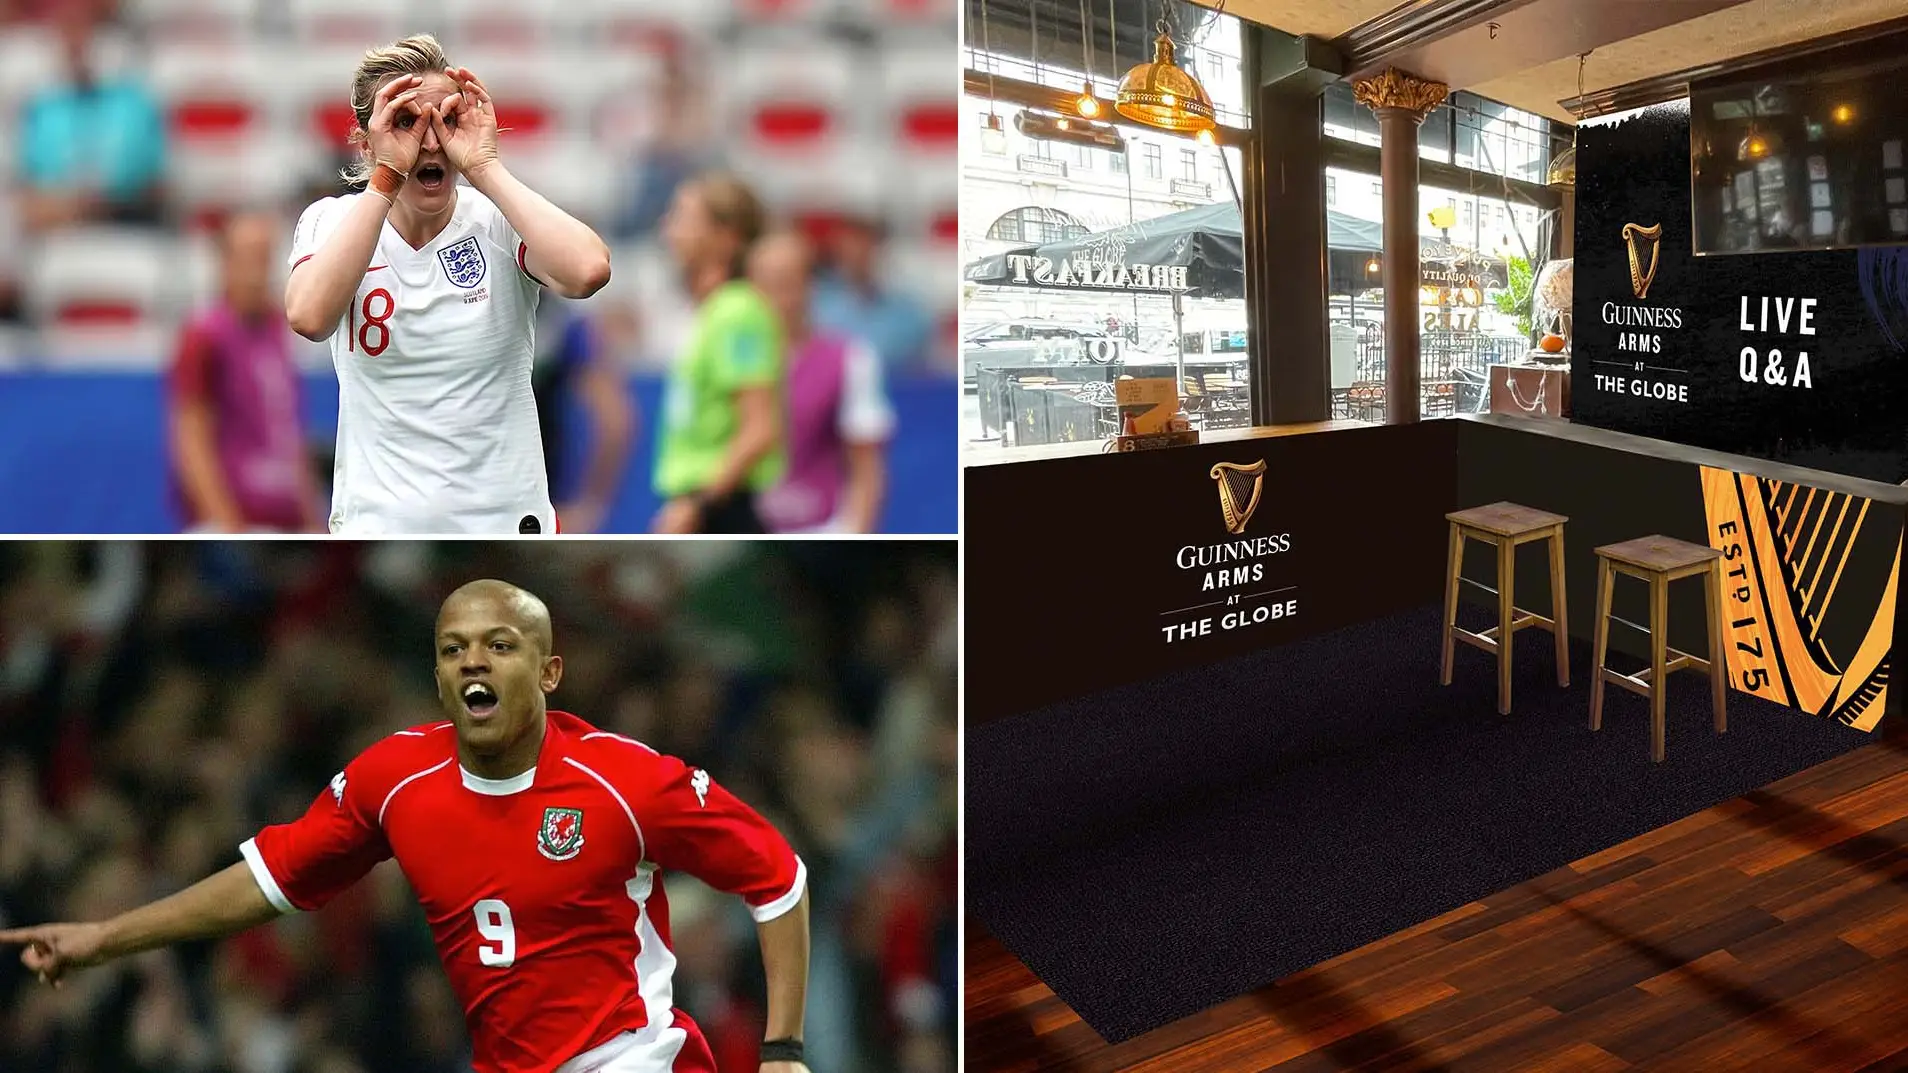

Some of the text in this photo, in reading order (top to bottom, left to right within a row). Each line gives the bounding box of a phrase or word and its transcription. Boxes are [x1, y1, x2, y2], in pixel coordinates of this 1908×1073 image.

[348, 287, 395, 357] 18
[1602, 301, 1682, 329] GUINNESS
[1740, 295, 1818, 336] LIVE
[1618, 332, 1661, 354] ARMS
[1634, 361, 1644, 372] AT
[1740, 346, 1812, 389] Q&A
[1594, 374, 1688, 403] THE GLOBE
[1176, 533, 1291, 570] GUINNESS
[1202, 563, 1264, 591] ARMS
[1226, 594, 1241, 606] AT
[1162, 600, 1297, 643] THE GLOBE
[473, 899, 516, 968] 9
